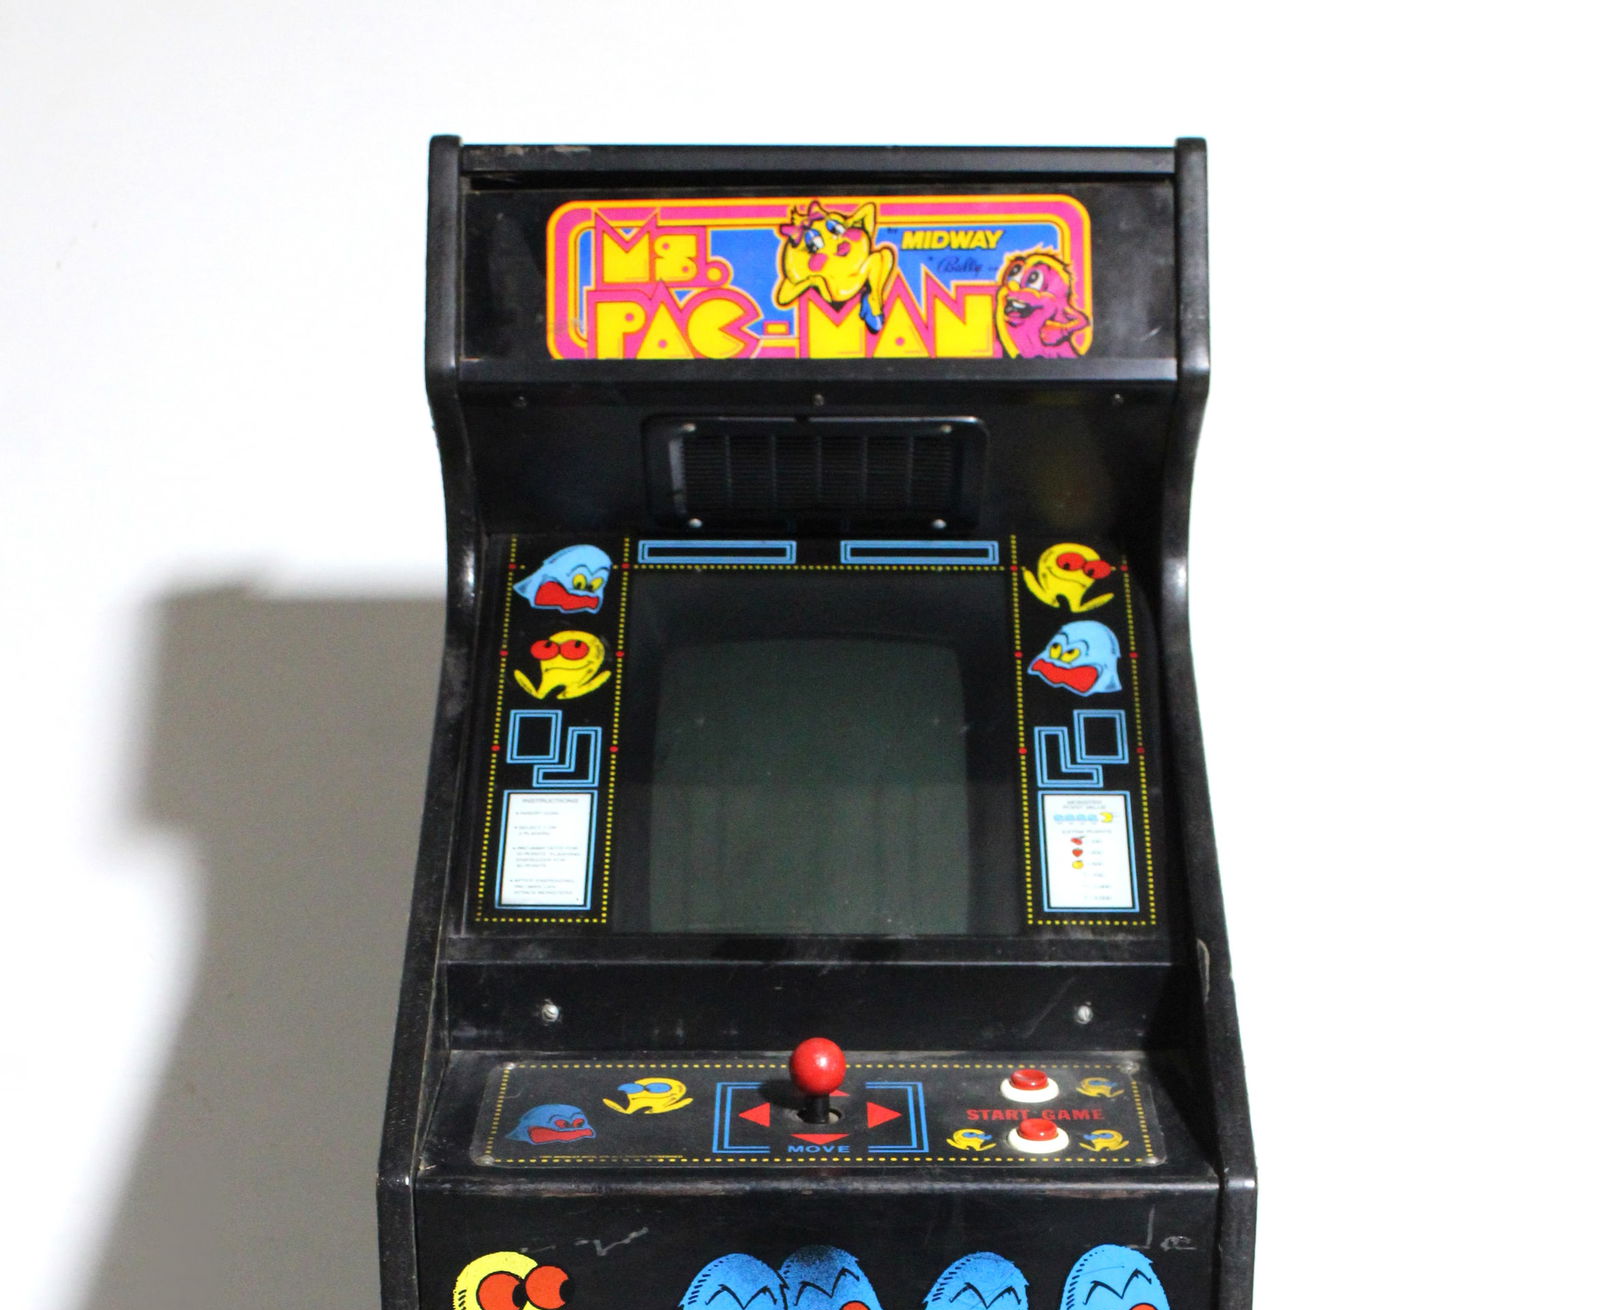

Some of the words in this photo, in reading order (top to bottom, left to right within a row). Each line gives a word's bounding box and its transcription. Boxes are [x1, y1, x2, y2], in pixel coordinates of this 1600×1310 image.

[901, 230, 1004, 250] MIDWAY
[594, 289, 996, 359] PAC-MAN
[966, 1109, 1030, 1120] START
[1041, 1109, 1105, 1120] GAME
[787, 1144, 851, 1153] MOVE
